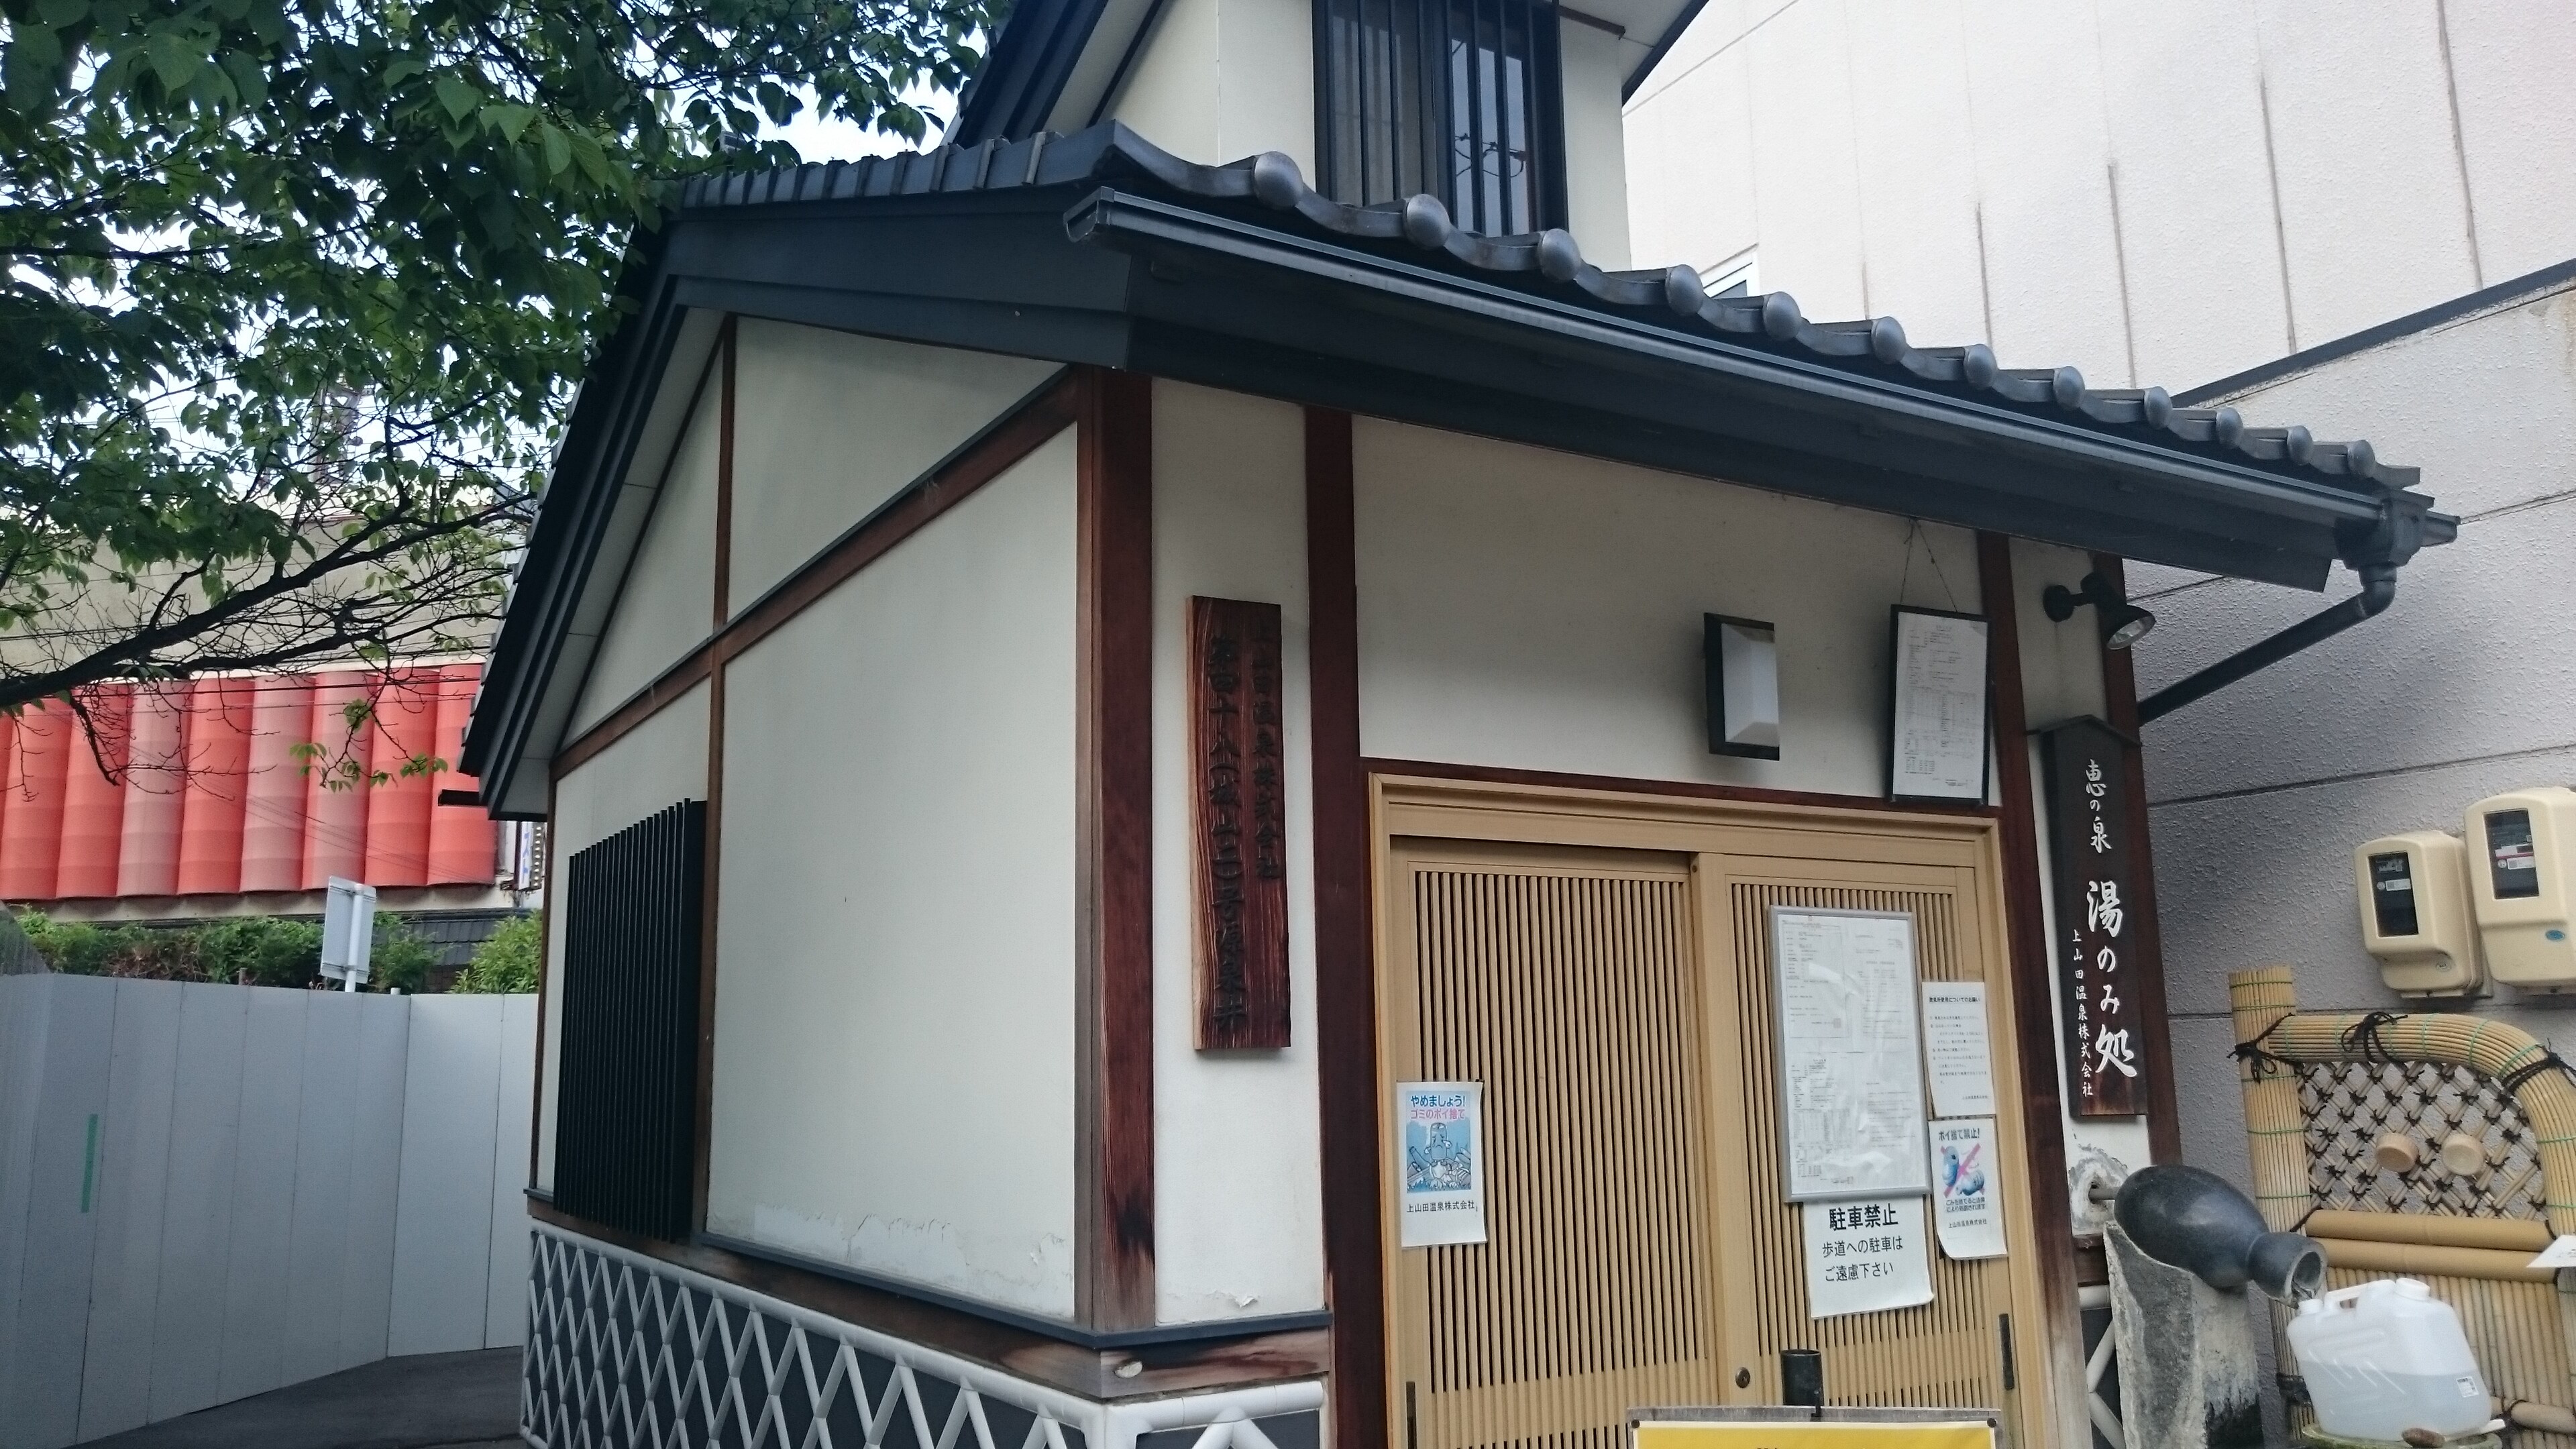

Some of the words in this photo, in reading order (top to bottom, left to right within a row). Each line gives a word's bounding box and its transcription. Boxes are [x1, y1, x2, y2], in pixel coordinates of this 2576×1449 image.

[2084, 758, 2112, 853] 恵の泉
[2086, 879, 2137, 1077] 湯のみ処
[2072, 928, 2094, 1097] 上山田温泉株式会社
[1411, 1108, 1465, 1120] ゴミのポイ捨て
[1407, 1199, 1475, 1213] 上山田温泉株式会社
[1829, 1203, 1898, 1232] 駐車禁止
[1949, 1219, 1987, 1228] 上山田温泉株式会社
[1822, 1235, 1903, 1258] 歩道への駐車は
[1825, 1262, 1894, 1282] ご遠慮下さい
